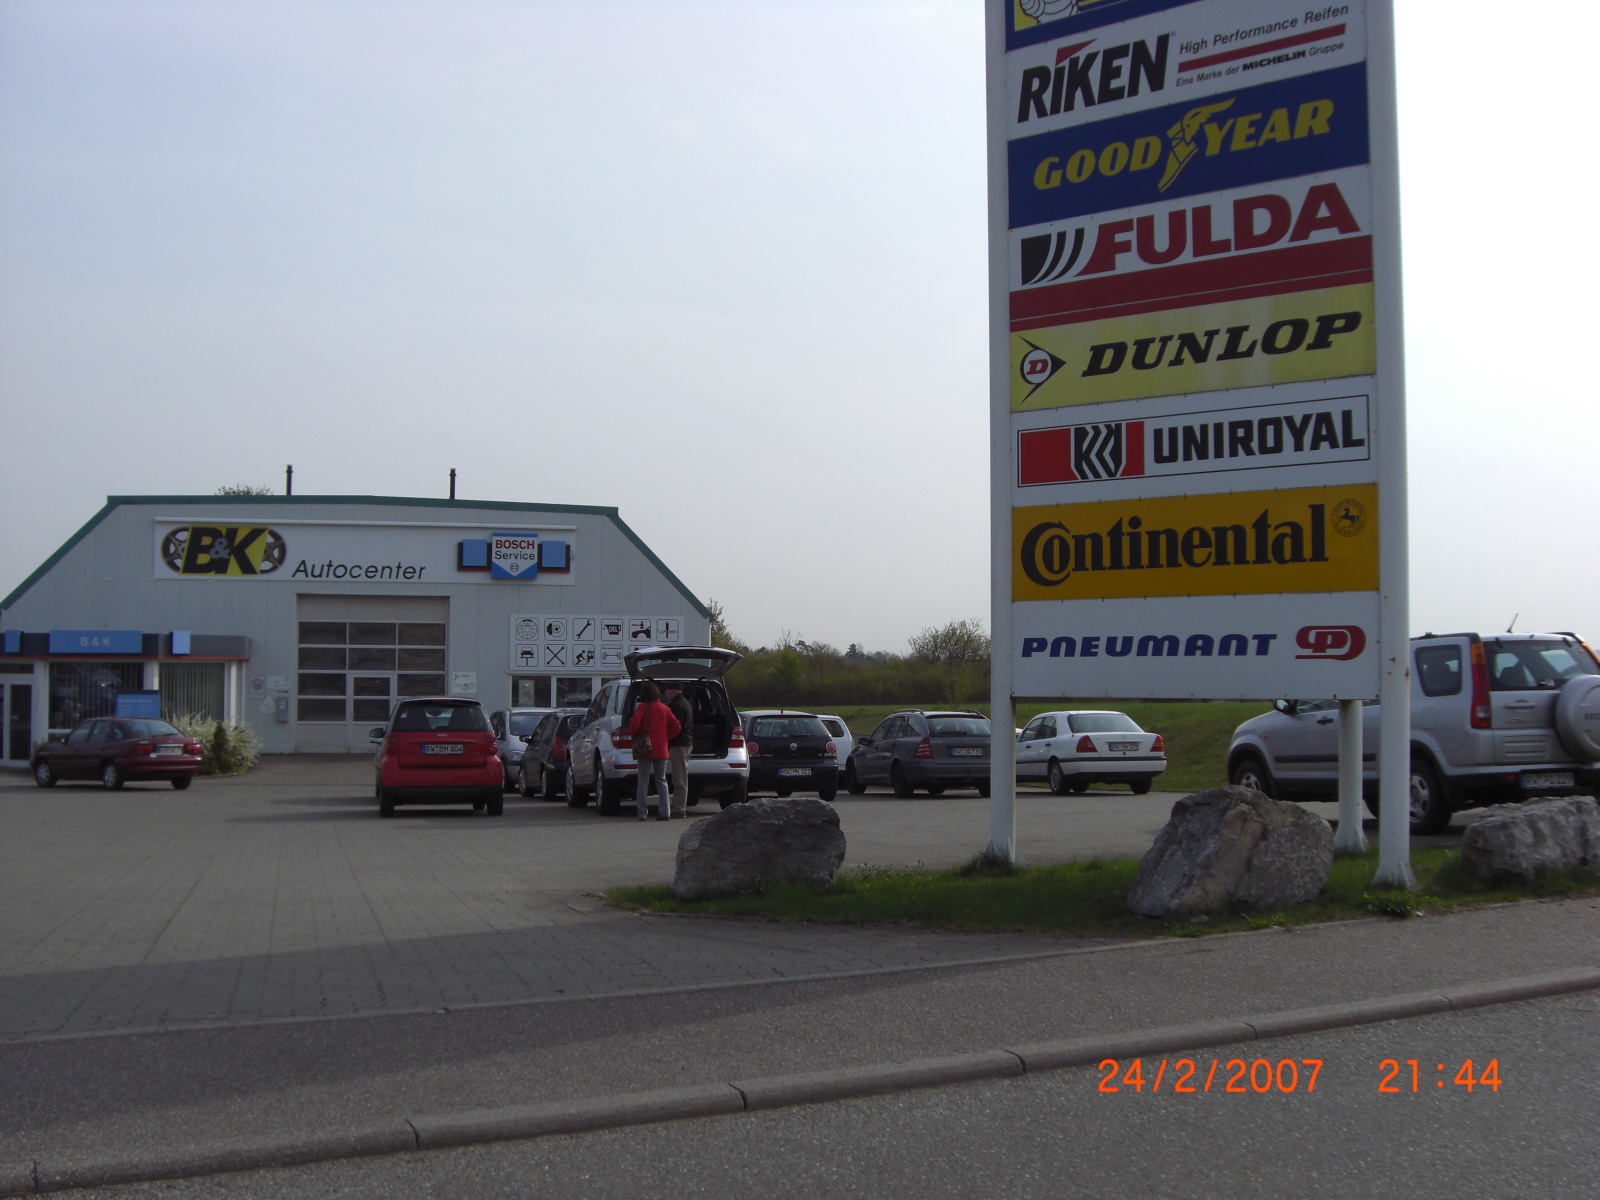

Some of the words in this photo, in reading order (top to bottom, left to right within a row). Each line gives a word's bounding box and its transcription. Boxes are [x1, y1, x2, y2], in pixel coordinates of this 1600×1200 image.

[1179, 38, 1208, 54] High
[1213, 17, 1299, 47] Performance
[1304, 5, 1349, 24] Reifen
[1017, 32, 1171, 124] RIKEN
[1176, 76, 1194, 87] Eine
[1196, 70, 1223, 82] Marke
[1225, 65, 1241, 76] der
[1242, 50, 1307, 72] MICHELIN
[1309, 41, 1345, 57] Gruppe
[1033, 135, 1162, 190] GOOD
[1204, 98, 1335, 157] YEAR
[1074, 182, 1361, 277] FULDA
[1081, 311, 1362, 378] DUNLOP
[1153, 409, 1365, 464] UNIROYAL
[291, 559, 426, 580] Autocenter
[494, 550, 536, 562] Service
[495, 539, 535, 551] BOSCH
[1020, 503, 1329, 587] Continental
